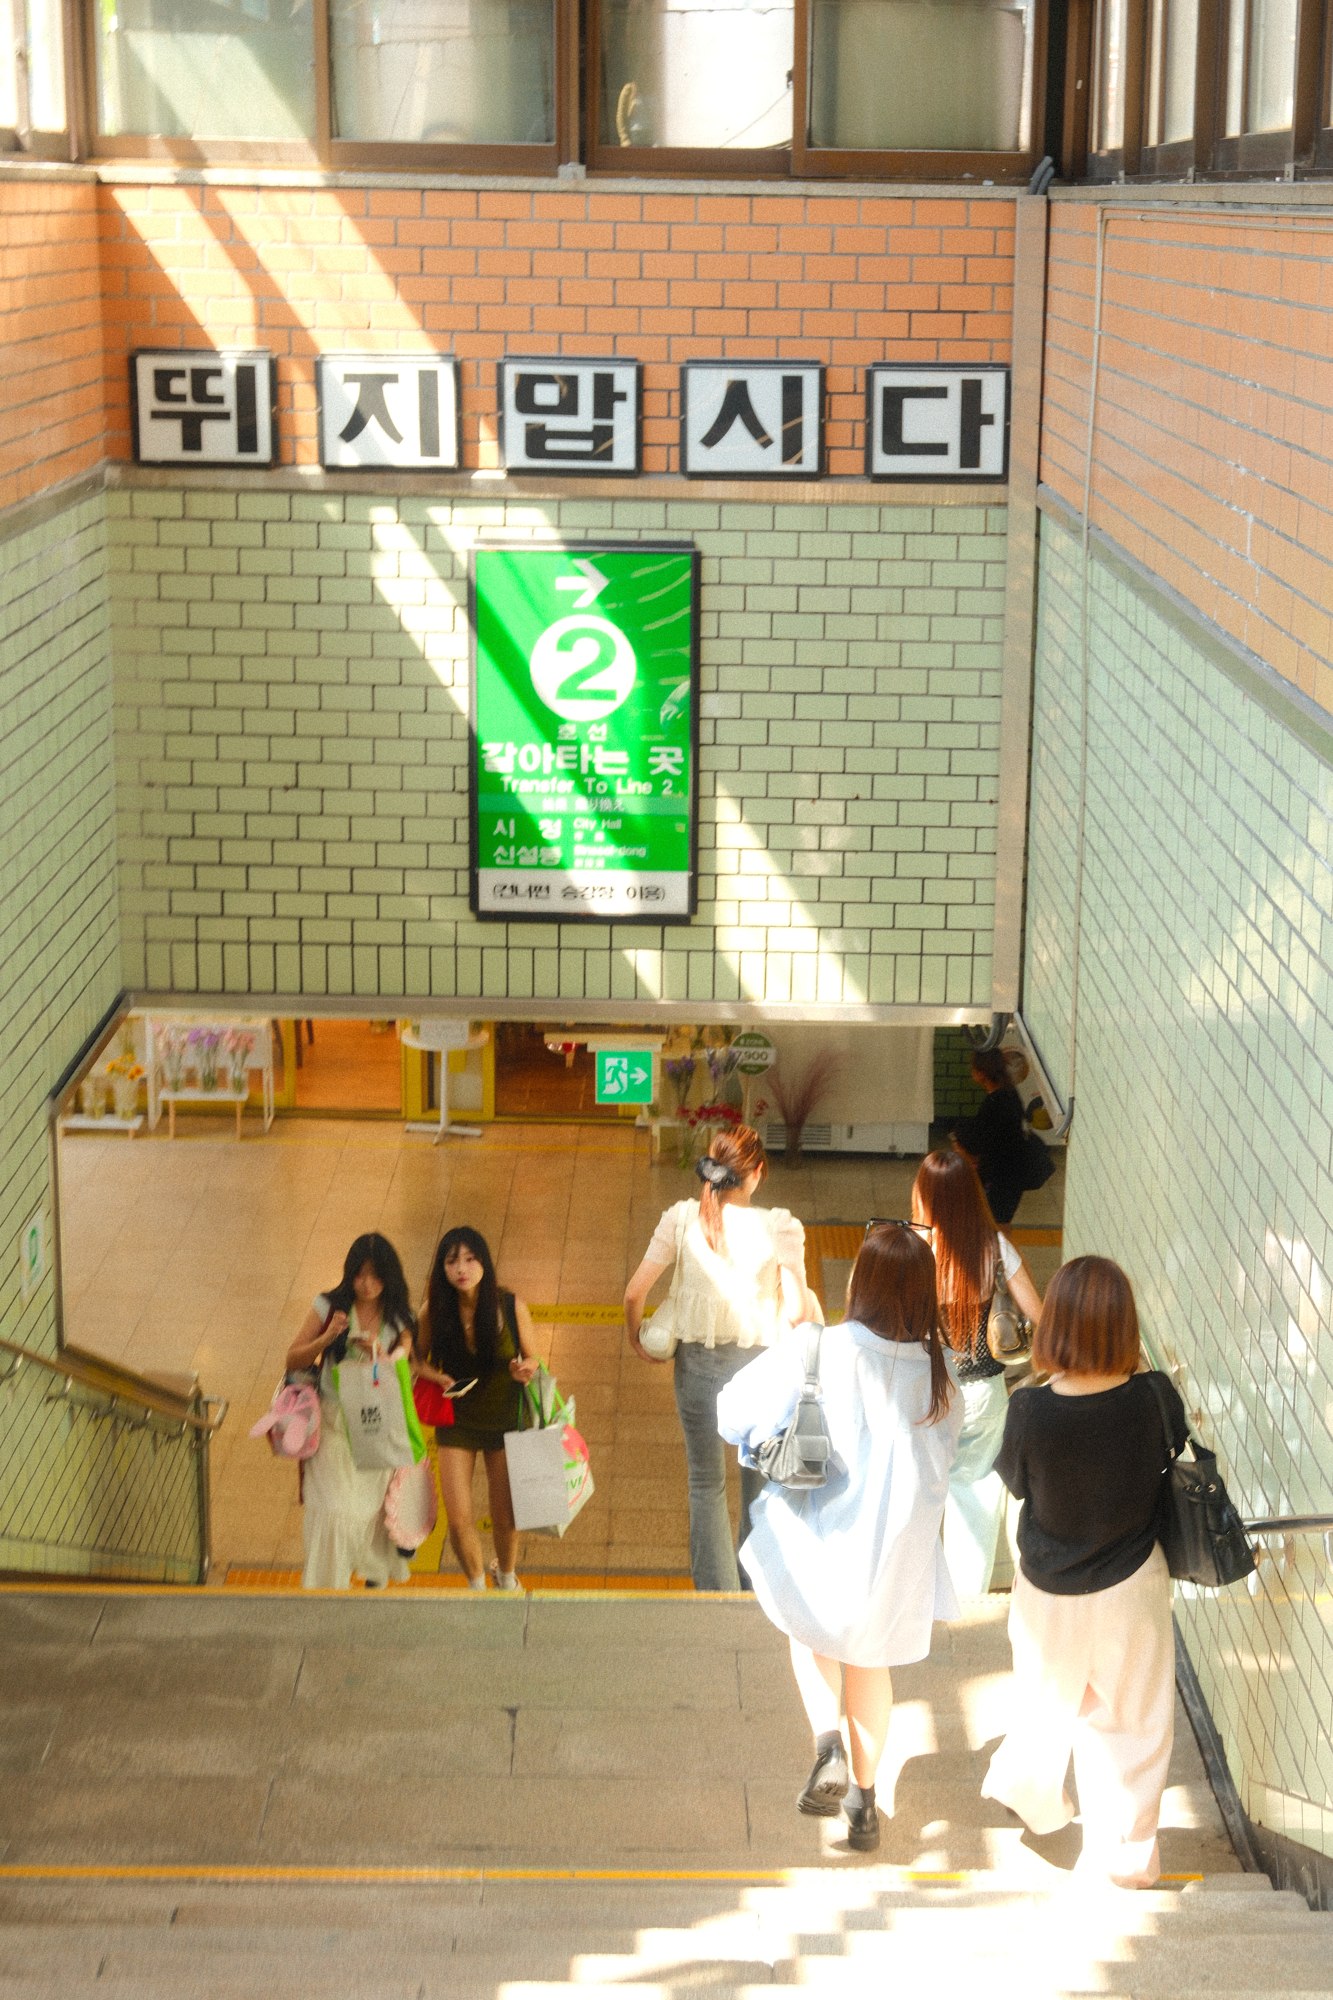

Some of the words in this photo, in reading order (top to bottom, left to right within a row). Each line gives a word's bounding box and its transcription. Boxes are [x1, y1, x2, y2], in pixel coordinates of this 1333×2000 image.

[555, 627, 618, 701] 2
[482, 741, 630, 775] 갈아타는
[648, 746, 685, 776] 곳
[501, 775, 575, 794] Transfer
[584, 777, 608, 795] To
[616, 777, 653, 796] Line
[662, 779, 674, 796] 2
[573, 817, 597, 831] City
